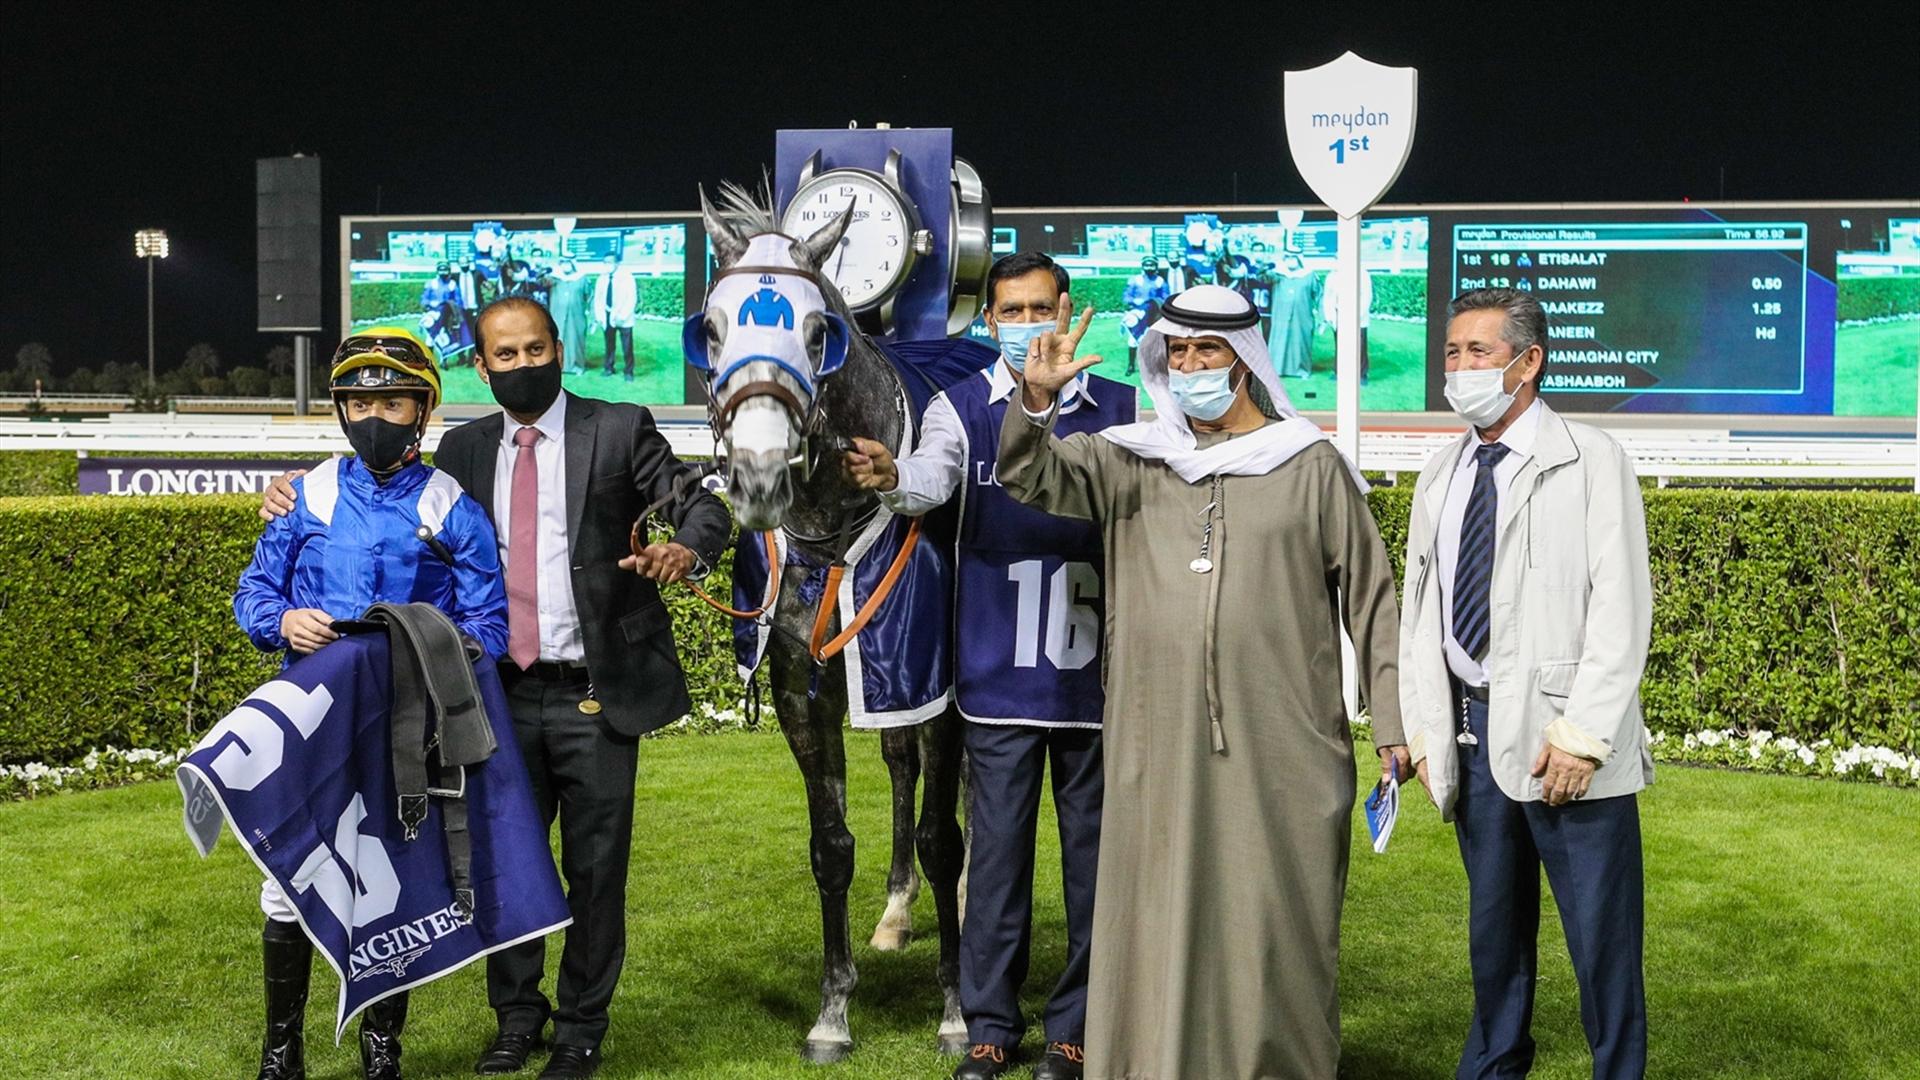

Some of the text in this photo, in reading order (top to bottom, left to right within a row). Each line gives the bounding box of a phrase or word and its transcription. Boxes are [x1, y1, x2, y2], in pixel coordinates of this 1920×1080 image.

[1312, 105, 1389, 133] meydan
[1329, 135, 1369, 164] 1st
[840, 186, 854, 197] 12
[819, 194, 828, 204] 11
[803, 211, 816, 221] 10
[823, 211, 870, 219] LONNES
[881, 210, 891, 221] 2
[1501, 230, 1556, 240] Provisional
[1559, 230, 1597, 240] Results
[1725, 229, 1750, 239] Time
[886, 235, 898, 247] 3
[879, 261, 889, 271] 4
[1462, 253, 1607, 266] 1st 16 ETISALAT
[864, 279, 873, 290] 5
[1461, 277, 1486, 289] 2nd
[1538, 277, 1597, 290] DAHAWI
[1752, 277, 1782, 290] 0.50
[1752, 302, 1781, 315] 1.25
[1548, 326, 1595, 339] ANEEN
[1755, 326, 1776, 339] Hd
[1548, 350, 1659, 363] HANAGHAI CITY
[1540, 375, 1625, 388] ASHAABOH
[107, 469, 286, 495] LONGIN
[1008, 559, 1100, 670] 16
[290, 792, 402, 936] 16
[349, 901, 473, 978] NGINES
